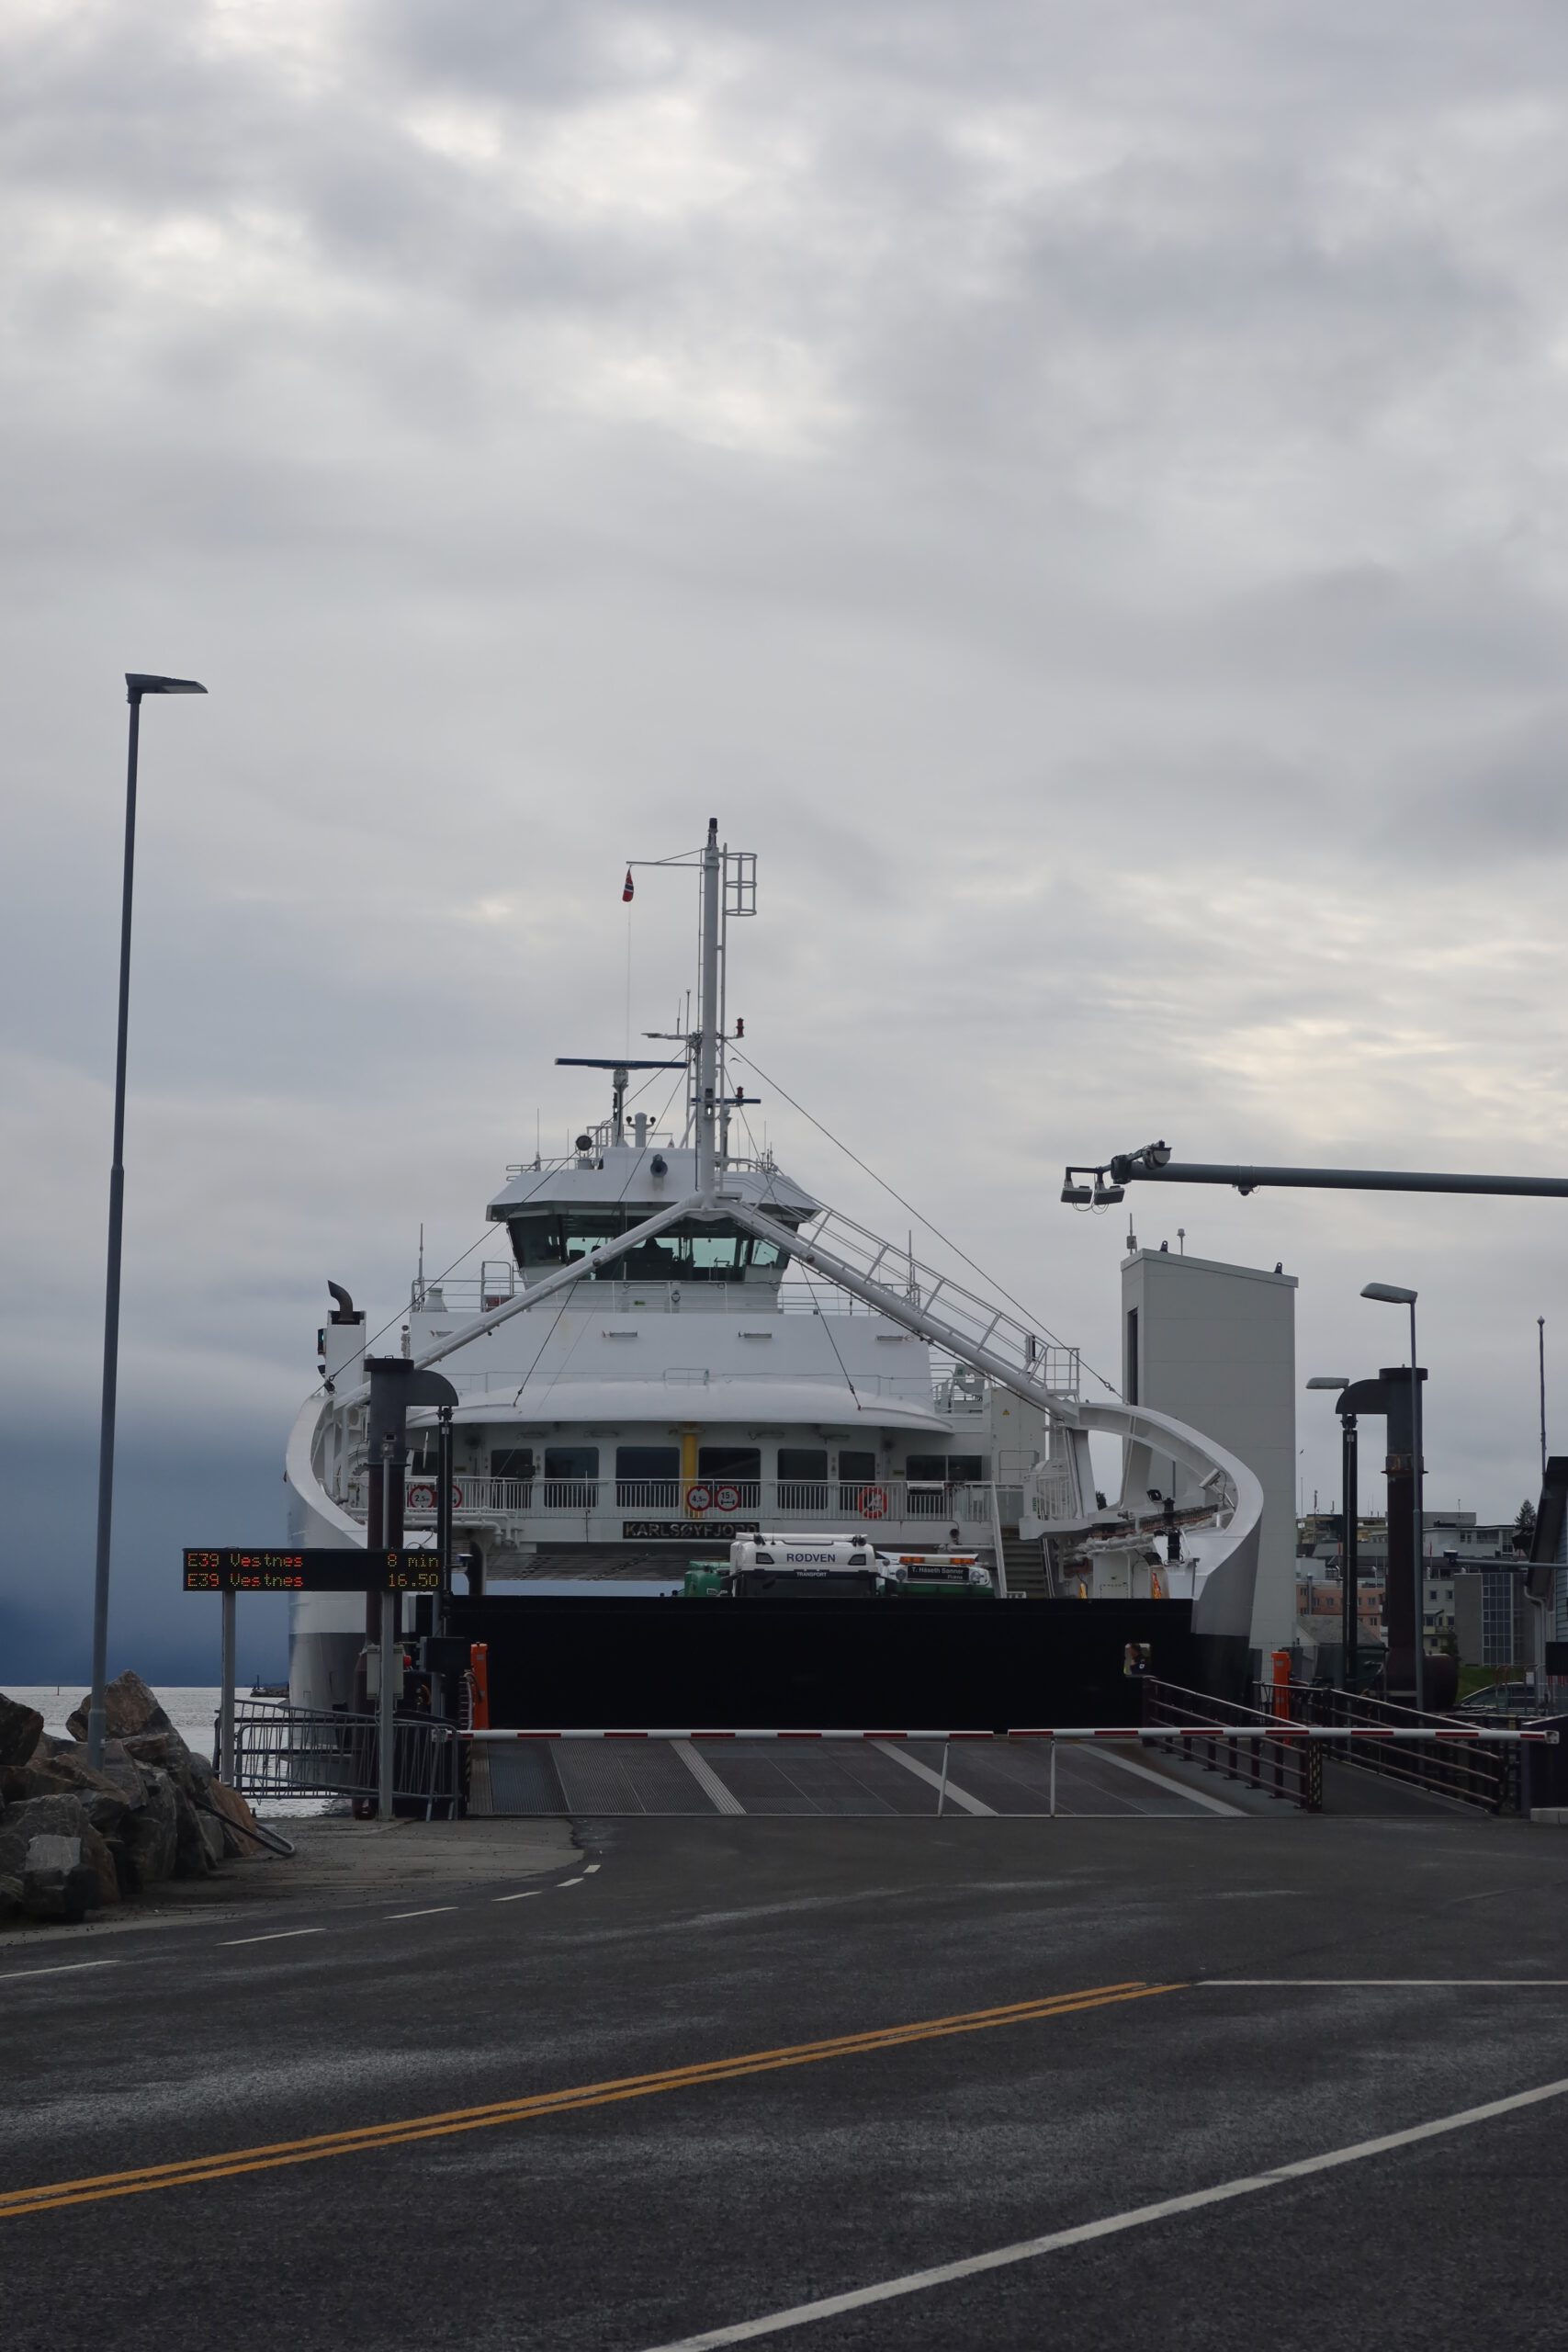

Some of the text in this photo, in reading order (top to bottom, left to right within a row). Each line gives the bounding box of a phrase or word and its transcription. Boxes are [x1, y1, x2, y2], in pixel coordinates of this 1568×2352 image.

[187, 1553, 439, 1567] E39 Vestnes 8 min
[786, 1553, 836, 1563] RØDVEN
[187, 1573, 439, 1588] E39 Vestnes 16.50
